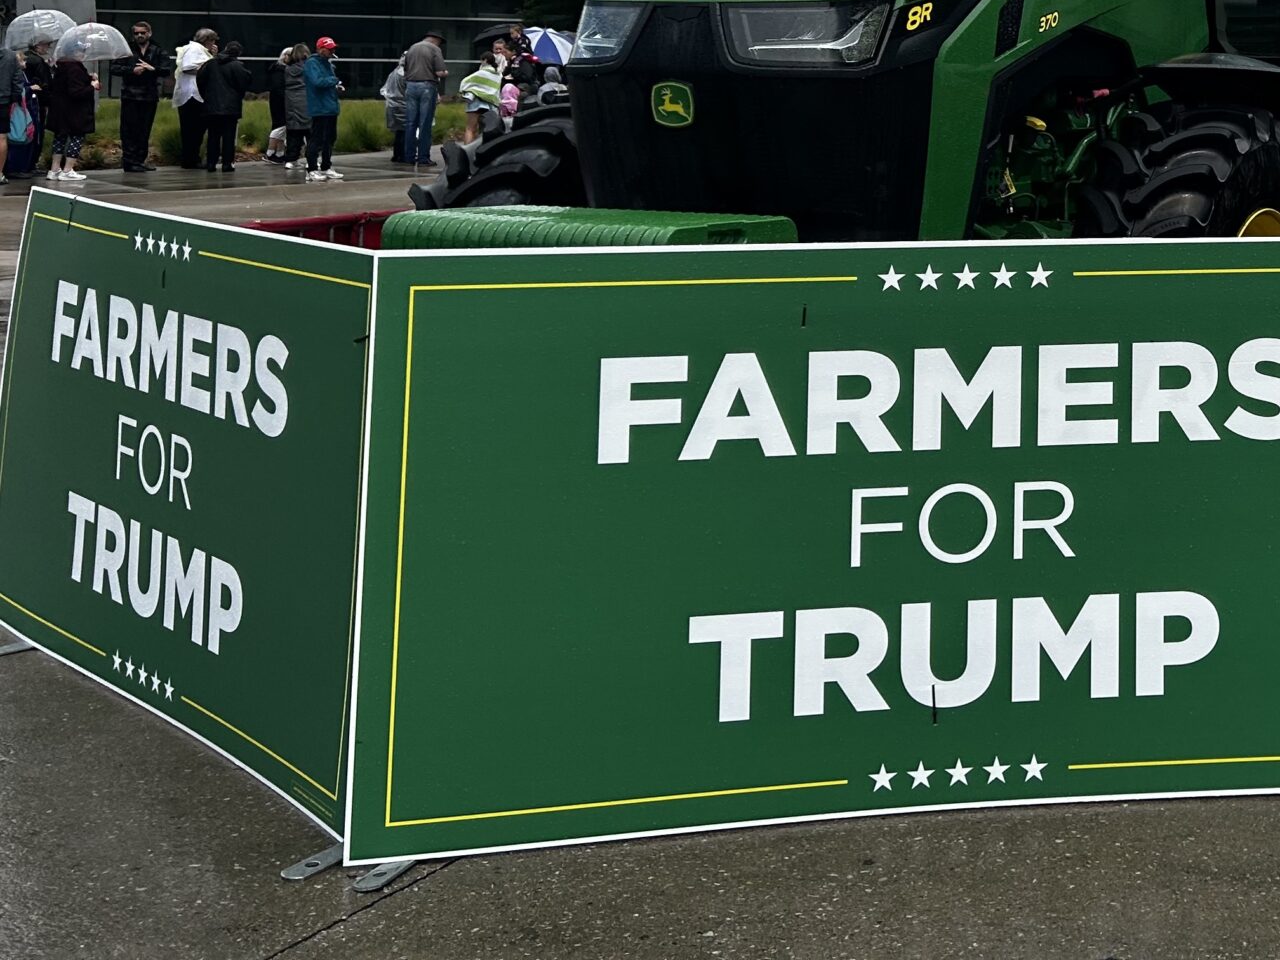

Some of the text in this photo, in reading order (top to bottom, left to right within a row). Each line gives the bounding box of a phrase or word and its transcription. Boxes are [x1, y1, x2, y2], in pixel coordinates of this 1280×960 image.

[906, 2, 933, 31] 8R
[1038, 11, 1059, 33] 370
[51, 279, 291, 438] FARMERS
[115, 413, 193, 511] FOR
[850, 480, 1077, 568] FOR
[67, 490, 244, 657] TRUMP
[688, 590, 1221, 723] TRUMP
